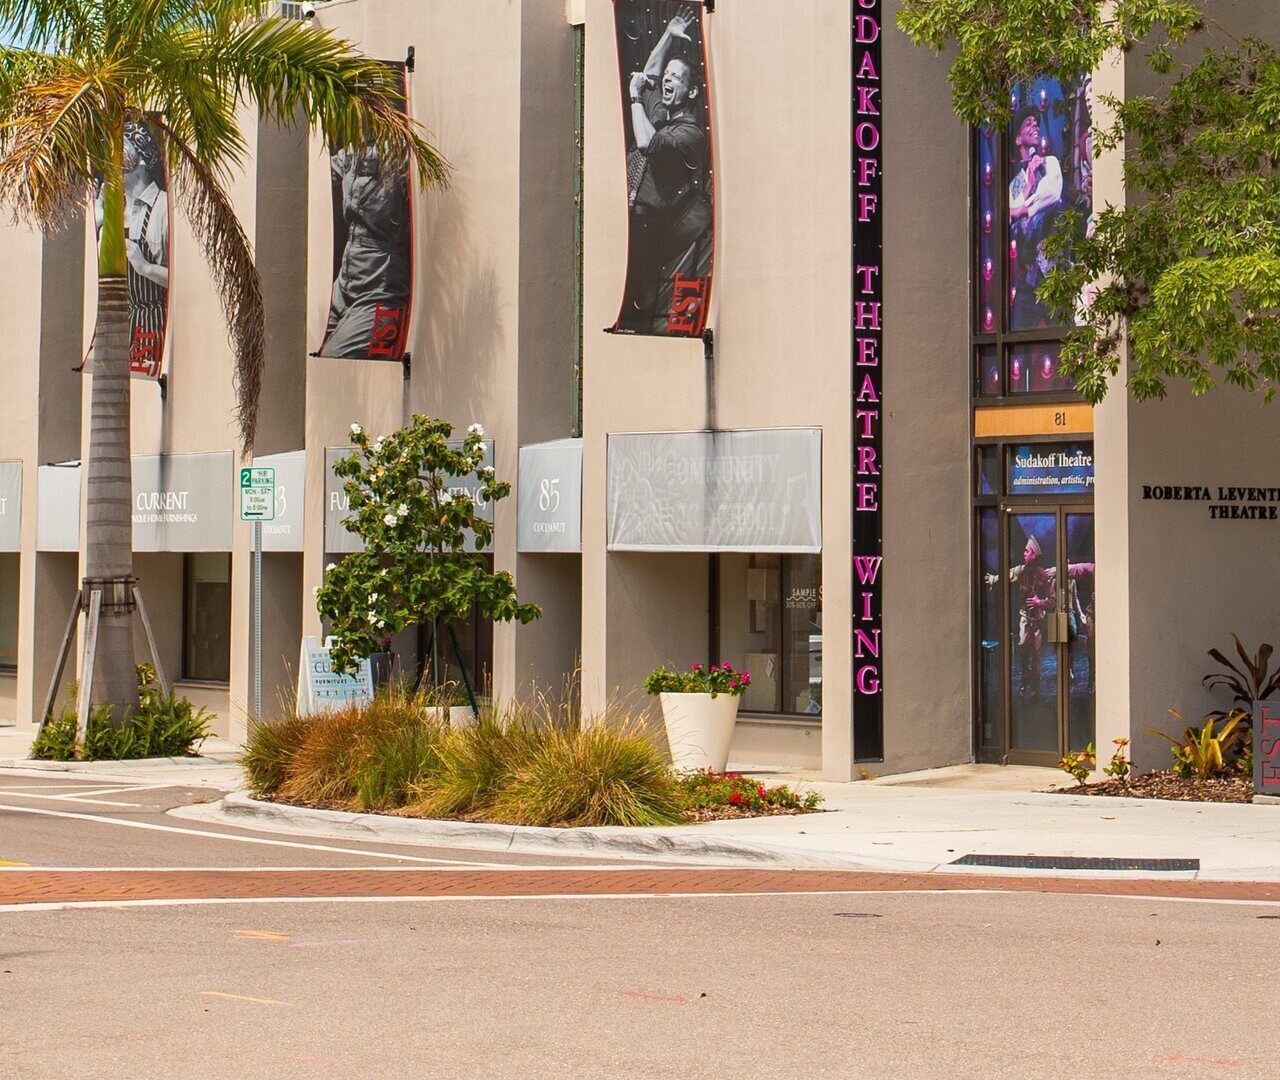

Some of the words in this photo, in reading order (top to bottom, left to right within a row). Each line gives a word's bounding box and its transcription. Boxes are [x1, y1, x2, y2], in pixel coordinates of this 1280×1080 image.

[666, 272, 701, 334] FST
[368, 302, 400, 357] FST
[128, 326, 156, 376] FST
[854, 264, 881, 512] THEATRE
[1055, 412, 1067, 426] 81
[1015, 452, 1056, 468] Sudakoff
[1057, 452, 1092, 467] Theatre
[242, 471, 251, 485] 2
[1013, 475, 1060, 486] administration,
[1061, 474, 1085, 486] artistic,
[539, 477, 560, 513] 85
[1142, 485, 1211, 500] ROBERTA
[136, 491, 189, 511] CURRENT
[1209, 505, 1278, 520] THEATRE
[533, 521, 566, 533] COCOANUT
[792, 588, 817, 597] SAMPLE
[853, 555, 883, 695] WING
